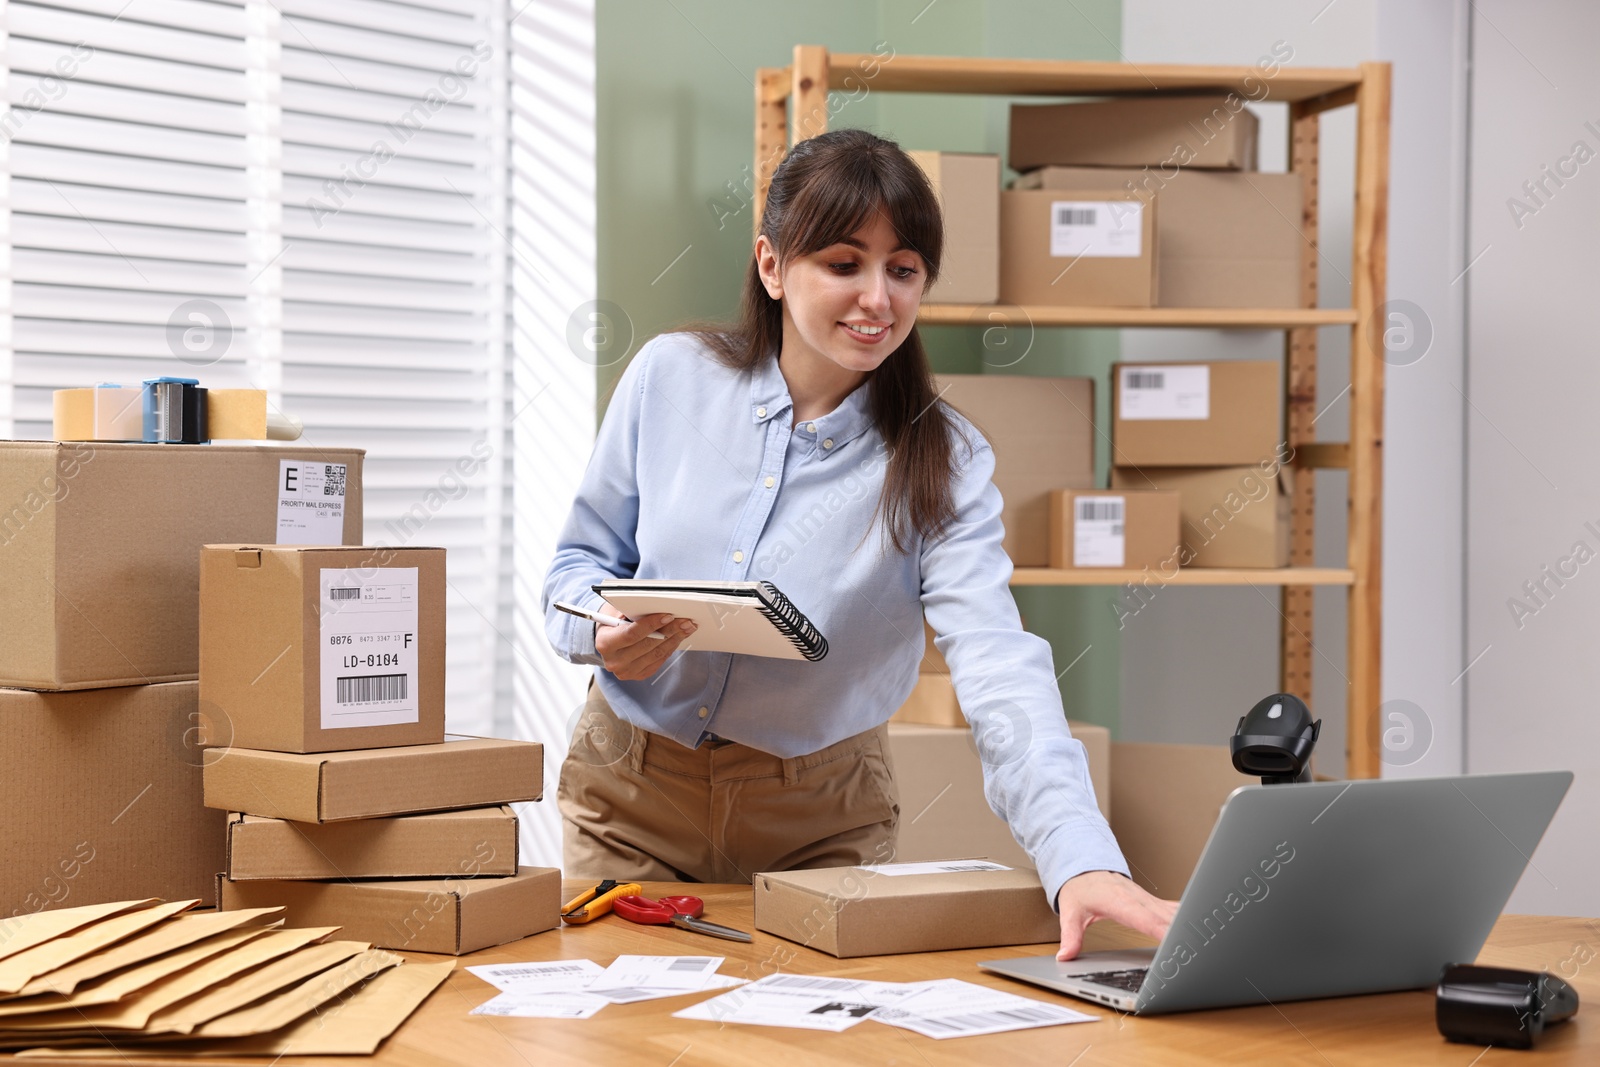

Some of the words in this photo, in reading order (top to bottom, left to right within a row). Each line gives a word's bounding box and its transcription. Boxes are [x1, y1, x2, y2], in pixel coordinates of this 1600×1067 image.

[286, 467, 298, 491] E
[330, 636, 353, 646] 0876
[404, 633, 412, 648] F
[344, 653, 398, 667] LD-0104
